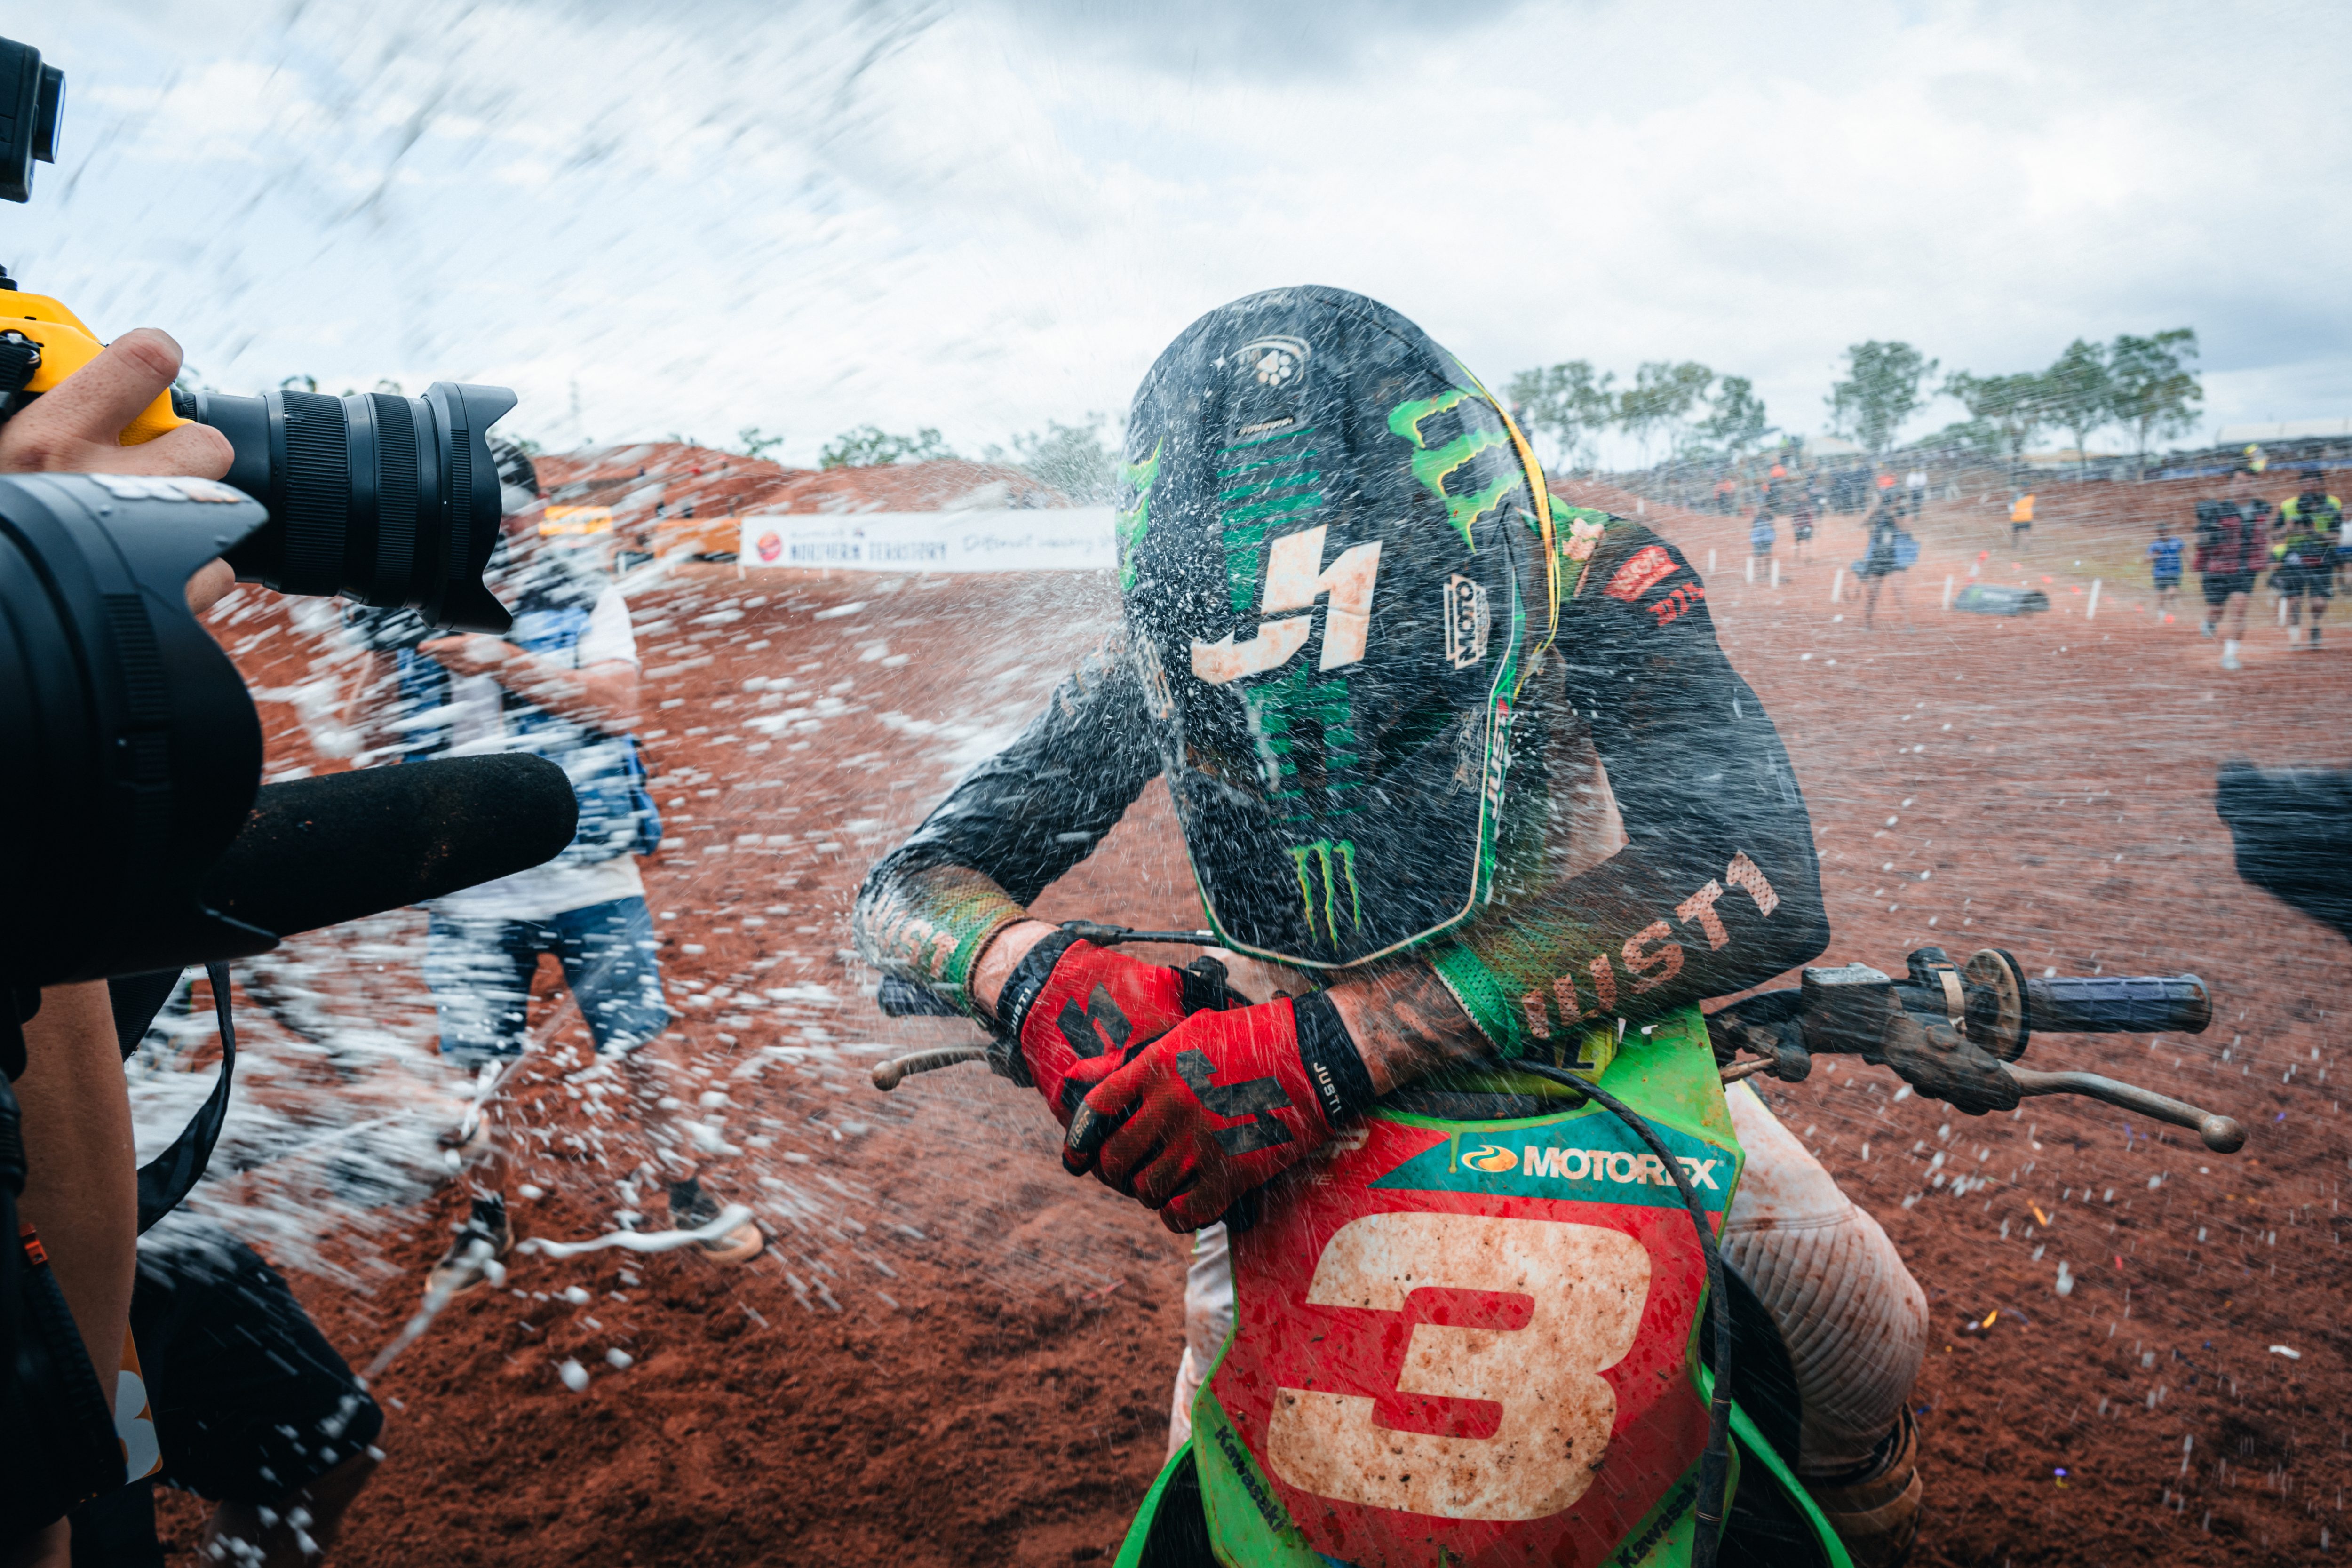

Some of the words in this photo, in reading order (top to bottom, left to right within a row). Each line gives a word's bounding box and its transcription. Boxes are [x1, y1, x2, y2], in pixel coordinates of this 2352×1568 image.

[1456, 581, 1477, 661] MOTO
[1011, 987, 1031, 1035] JUST1
[1313, 1062, 1342, 1114] JUST1
[1268, 1211, 1652, 1521] 3
[1215, 1425, 1287, 1533] Kawasaki
